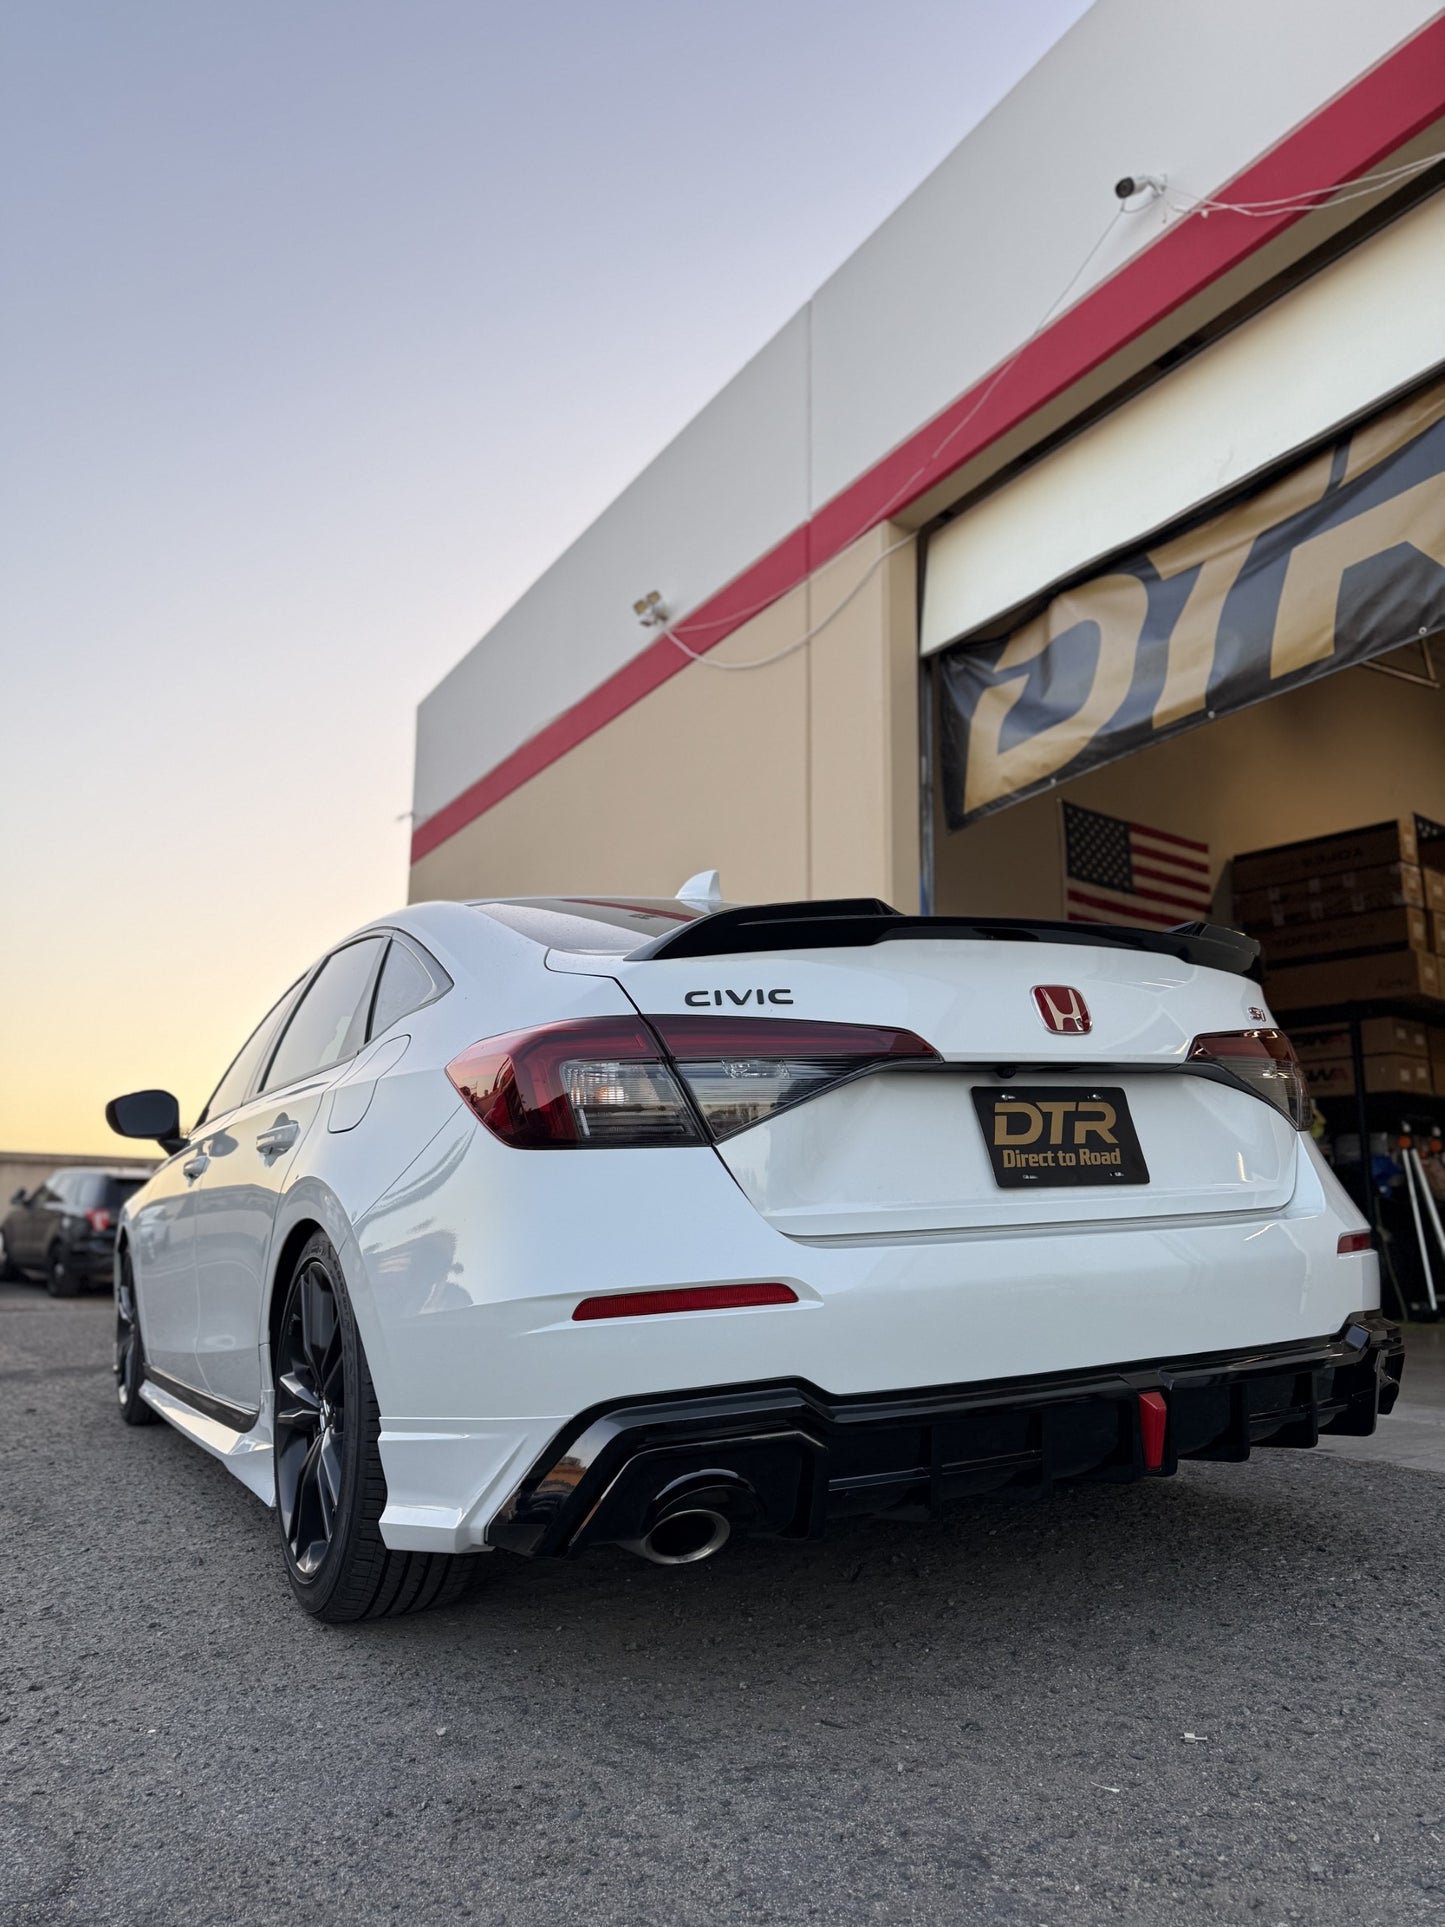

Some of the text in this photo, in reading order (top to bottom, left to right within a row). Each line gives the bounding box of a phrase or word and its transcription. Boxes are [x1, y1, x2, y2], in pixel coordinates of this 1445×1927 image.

[684, 988, 794, 1007] CIVIC
[994, 1101, 1119, 1145] DTR
[1003, 1148, 1122, 1168] Direct to Road
